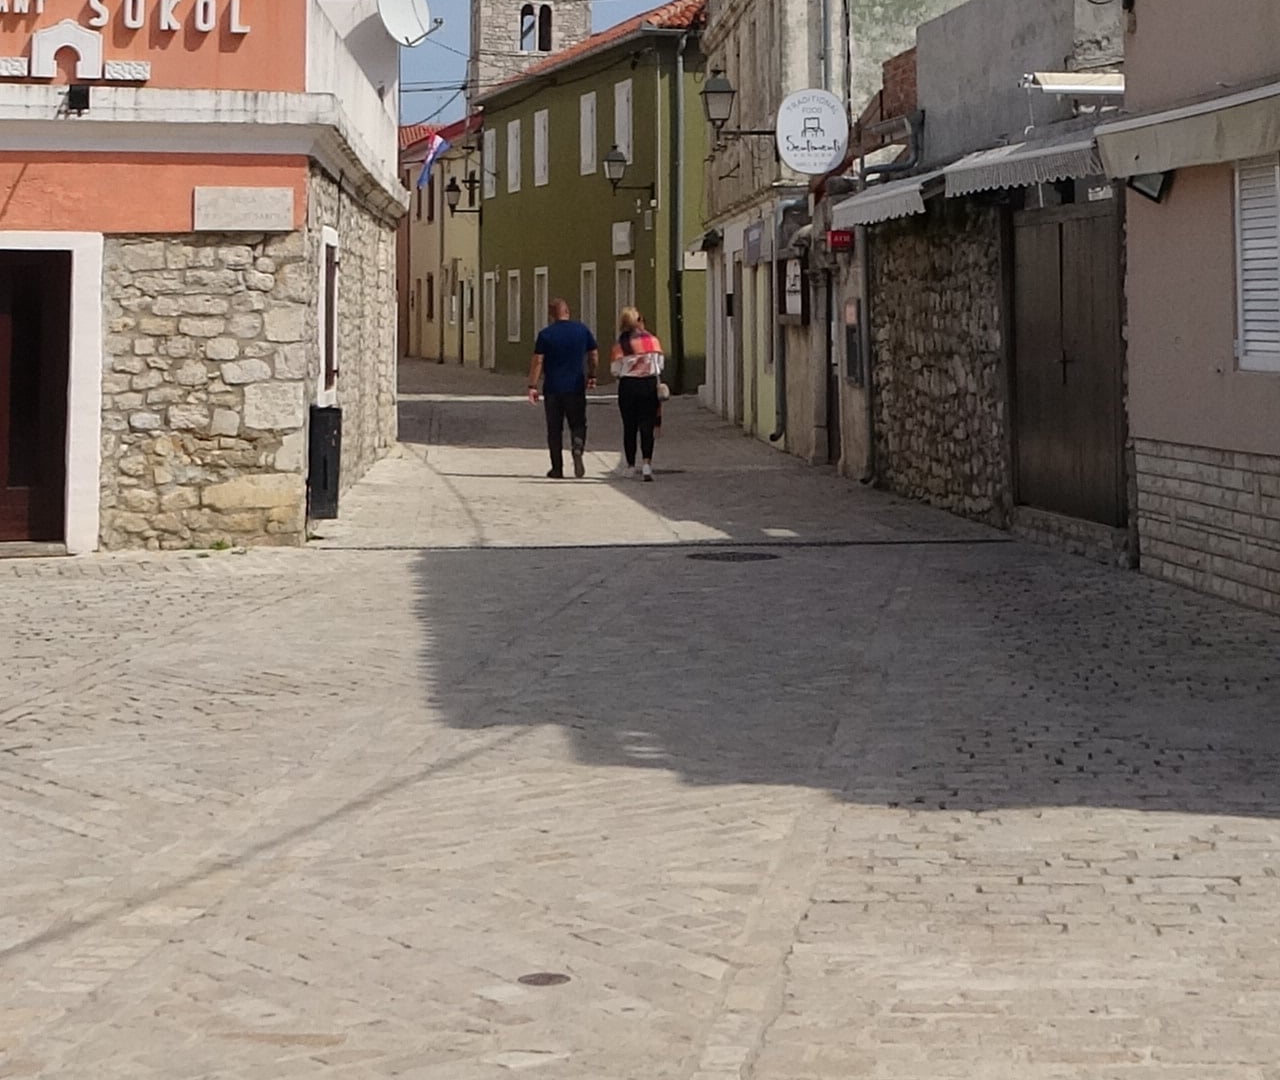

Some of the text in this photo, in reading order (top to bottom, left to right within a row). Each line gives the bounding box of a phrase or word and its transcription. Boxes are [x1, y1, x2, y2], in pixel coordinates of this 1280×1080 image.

[786, 95, 839, 115] TRADITIONAL
[802, 106, 822, 114] FOOD
[786, 135, 840, 152] Sentimenti
